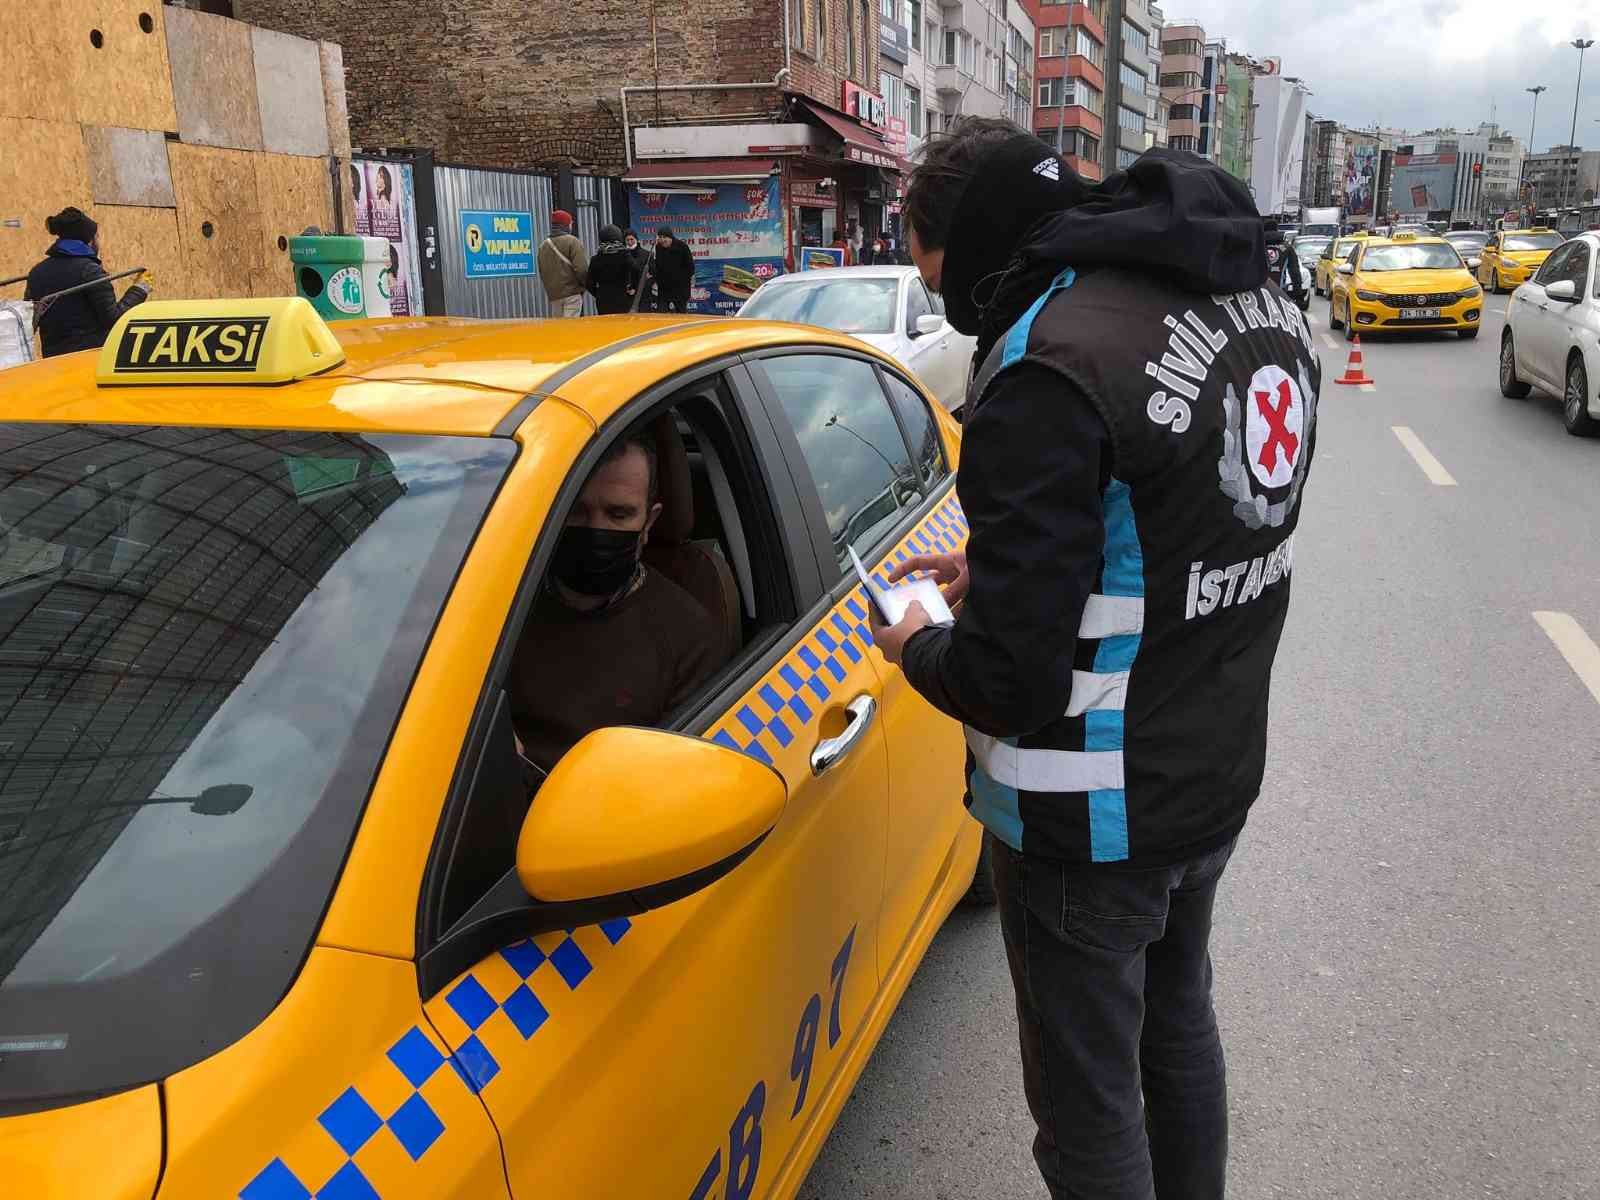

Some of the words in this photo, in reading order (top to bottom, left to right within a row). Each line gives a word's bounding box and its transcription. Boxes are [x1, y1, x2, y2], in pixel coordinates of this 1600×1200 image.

[494, 217, 520, 232] PARK
[484, 239, 531, 255] YAPILMAZ
[1145, 309, 1229, 434] SİVİL
